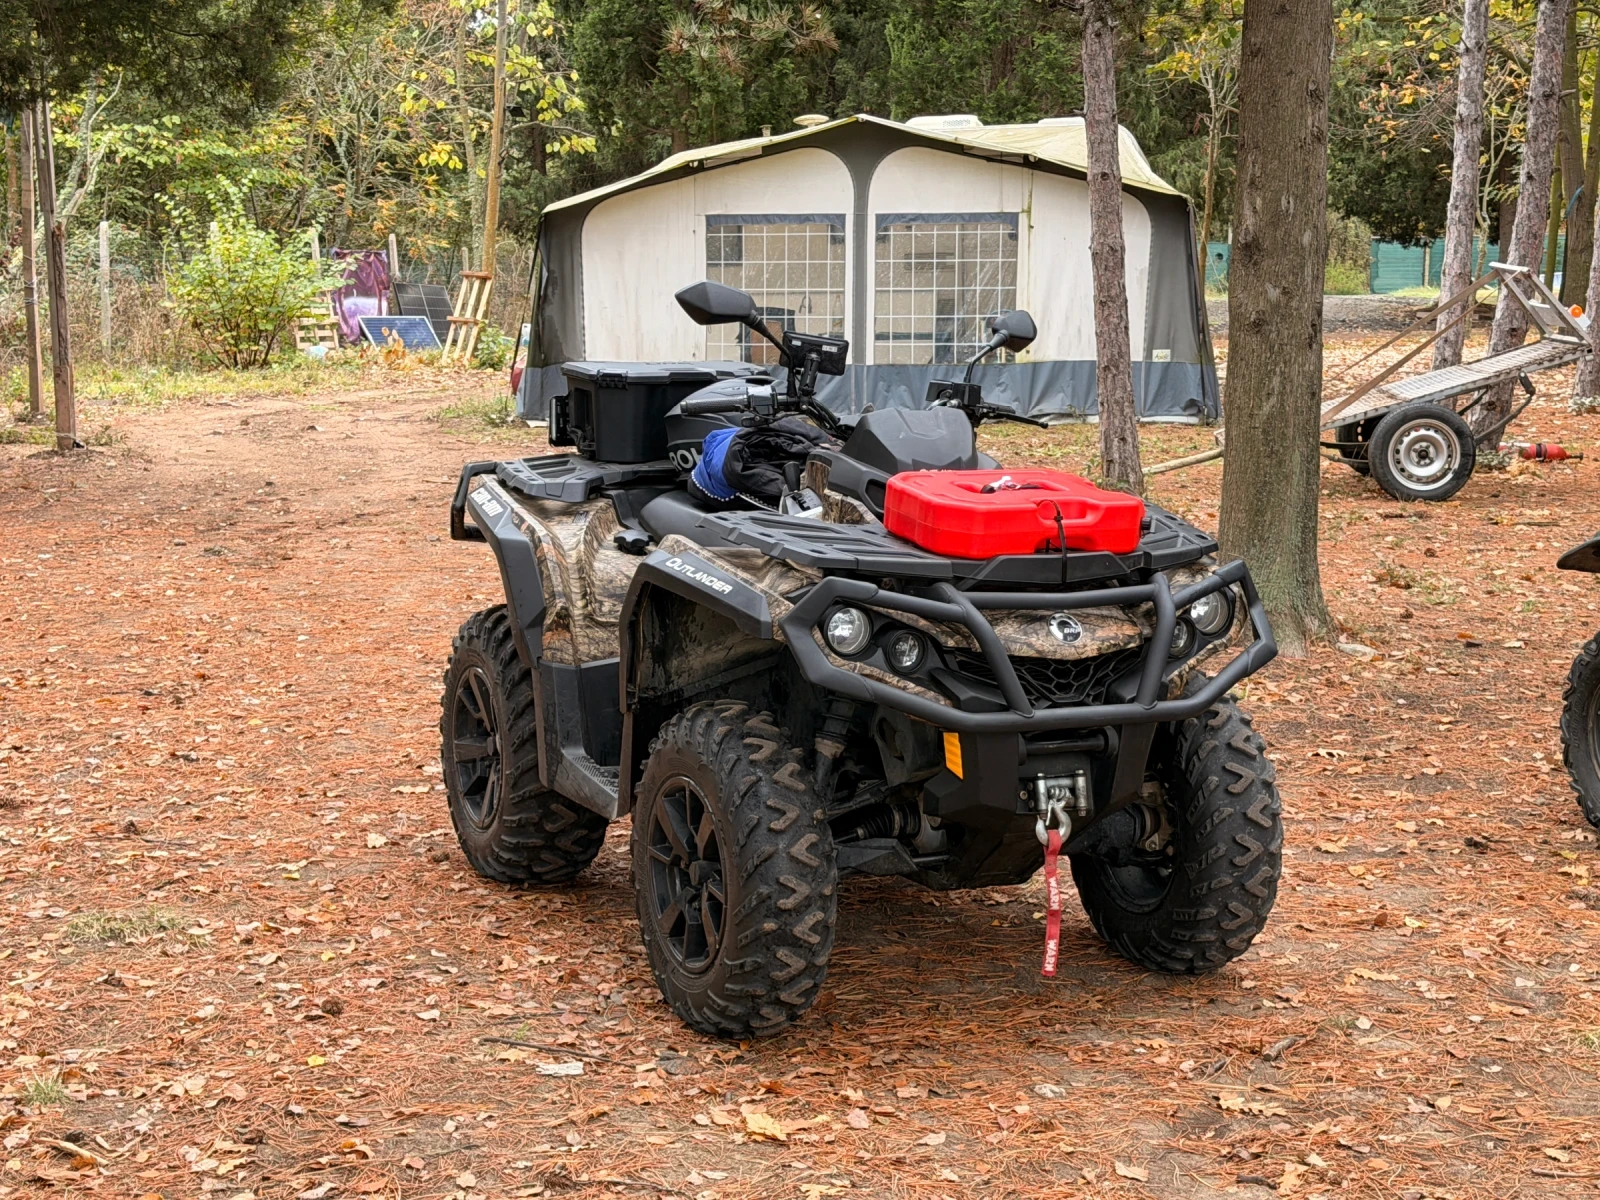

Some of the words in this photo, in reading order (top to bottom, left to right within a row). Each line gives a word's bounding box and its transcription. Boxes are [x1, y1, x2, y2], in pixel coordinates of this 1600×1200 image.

[665, 557, 733, 594] OUTLANDER
[1048, 876, 1060, 911] WARN
[1044, 939, 1057, 972] WARN
